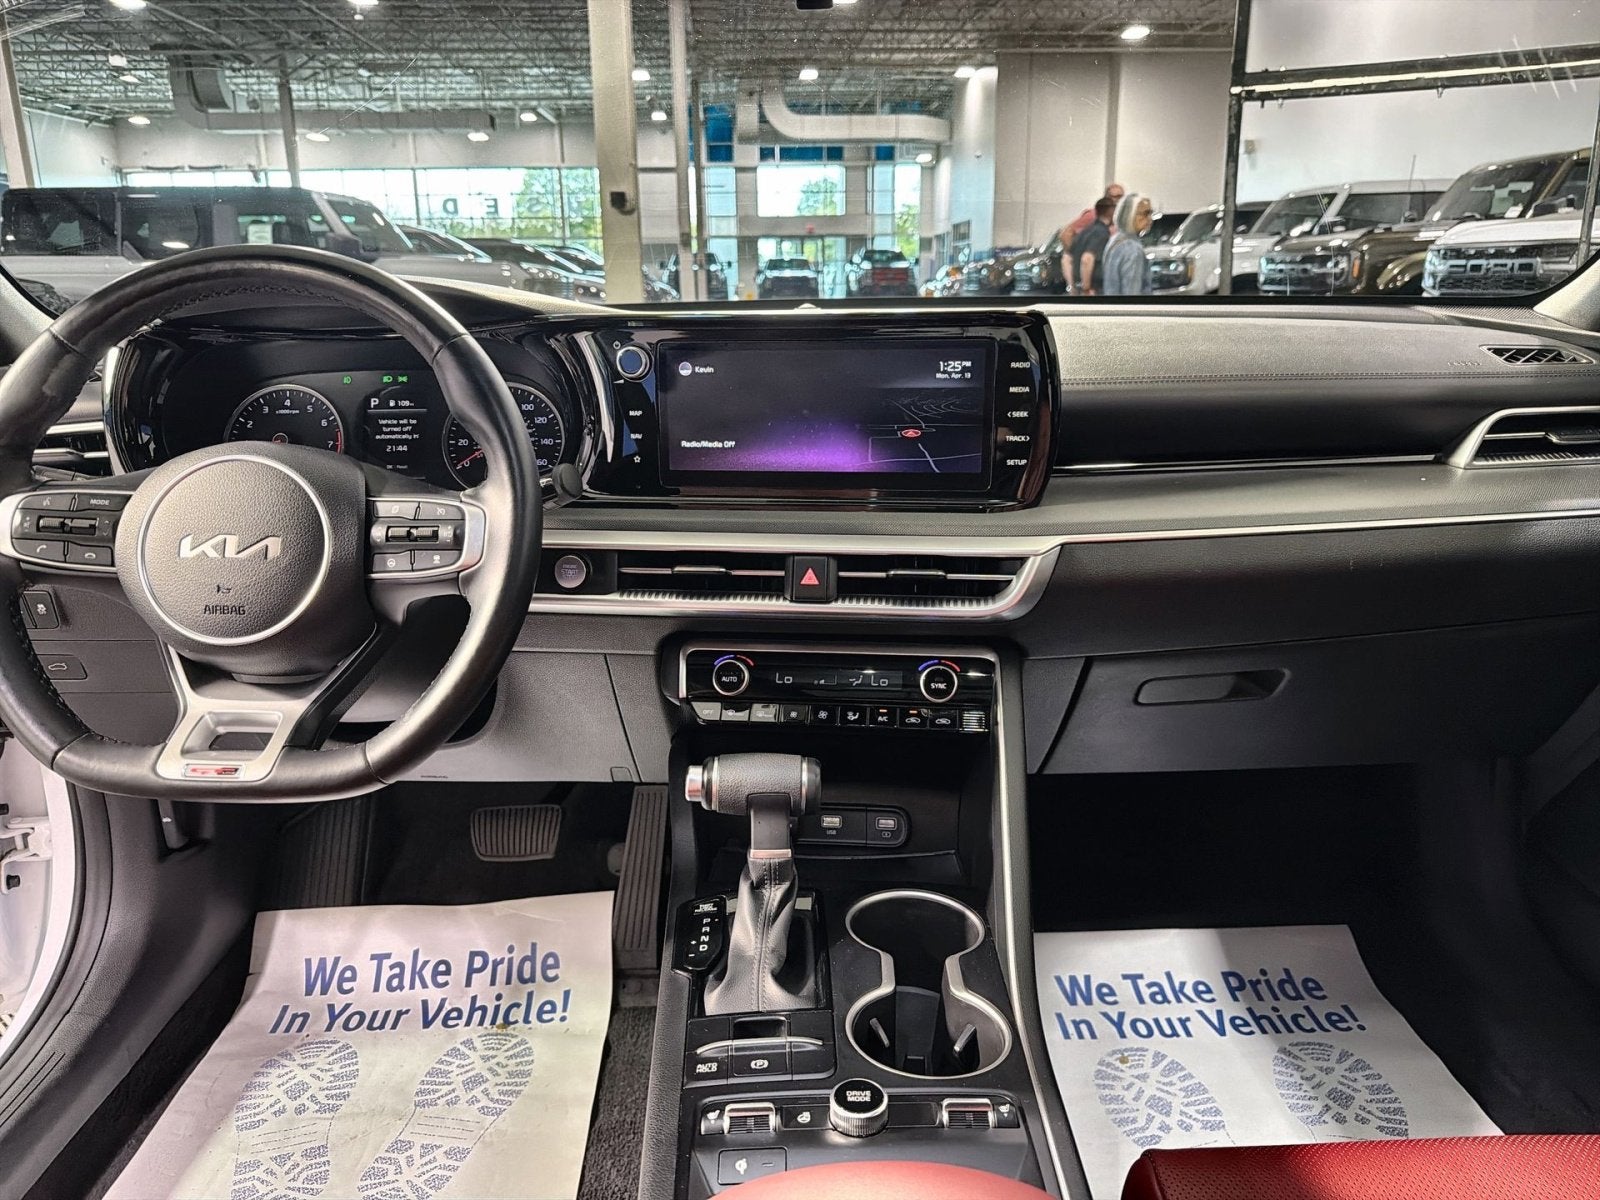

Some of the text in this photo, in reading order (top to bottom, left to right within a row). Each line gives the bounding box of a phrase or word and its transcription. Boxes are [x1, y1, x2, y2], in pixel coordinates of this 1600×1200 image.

[939, 361, 962, 372] 1:25
[284, 399, 291, 407] 4
[370, 398, 379, 409] P
[521, 403, 535, 411] 100
[262, 406, 269, 414] 3
[306, 405, 313, 413] 5
[534, 416, 547, 424] 120
[327, 440, 334, 449] 7
[540, 438, 553, 446] 140
[681, 440, 736, 448] Radio/Media Off
[89, 498, 110, 506] MODE
[203, 604, 246, 615] AIRBAG
[721, 675, 738, 683] AUTO
[930, 682, 947, 690] SYNC
[699, 944, 708, 952] D
[303, 942, 561, 997] We Take Pride
[1054, 967, 1328, 1007] We Take Pride
[269, 989, 572, 1034] In Your Vehicle!
[1054, 1004, 1368, 1040] In Your Vehicle!
